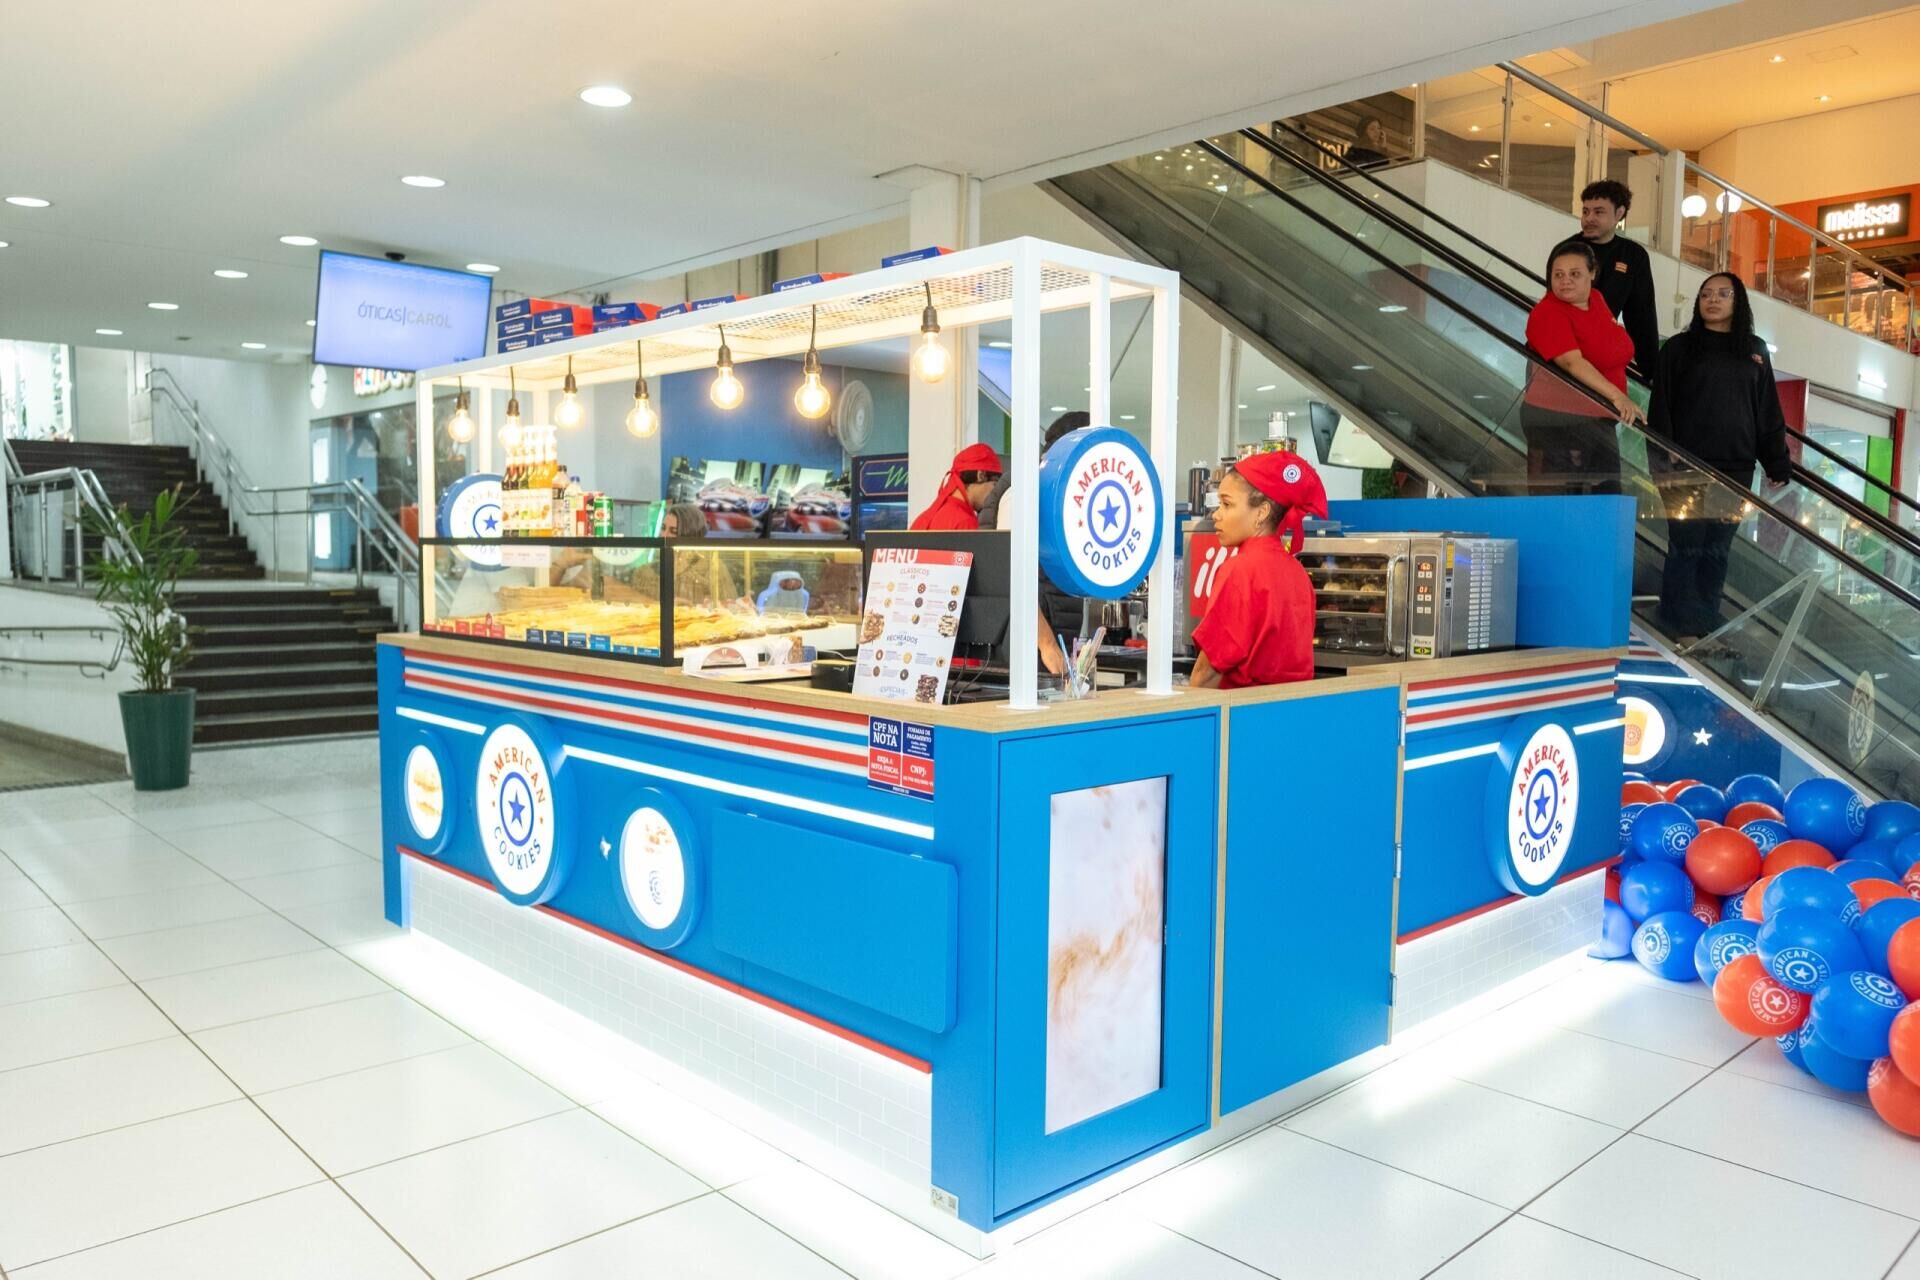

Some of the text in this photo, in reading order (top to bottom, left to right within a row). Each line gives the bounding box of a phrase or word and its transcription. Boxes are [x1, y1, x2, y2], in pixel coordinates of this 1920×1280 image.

[1824, 202, 1900, 233] melissa
[358, 300, 452, 329] ÓTICAS CAROL
[1073, 457, 1144, 508] AMERICAN
[875, 548, 919, 564] MENU
[1083, 527, 1142, 570] COOKIES
[873, 721, 899, 735] CPF NA
[873, 731, 898, 747] NOTA
[488, 747, 546, 803] AMERICAN
[1518, 745, 1570, 796] AMERICAN
[494, 826, 541, 870] COOKIES
[1518, 819, 1563, 863] COOKIES
[1713, 935, 1736, 969] MERICAN
[1775, 950, 1809, 982] AMERICAN
[1751, 981, 1778, 1023] AMERICAN
[1854, 976, 1899, 1006] AMERICAN
